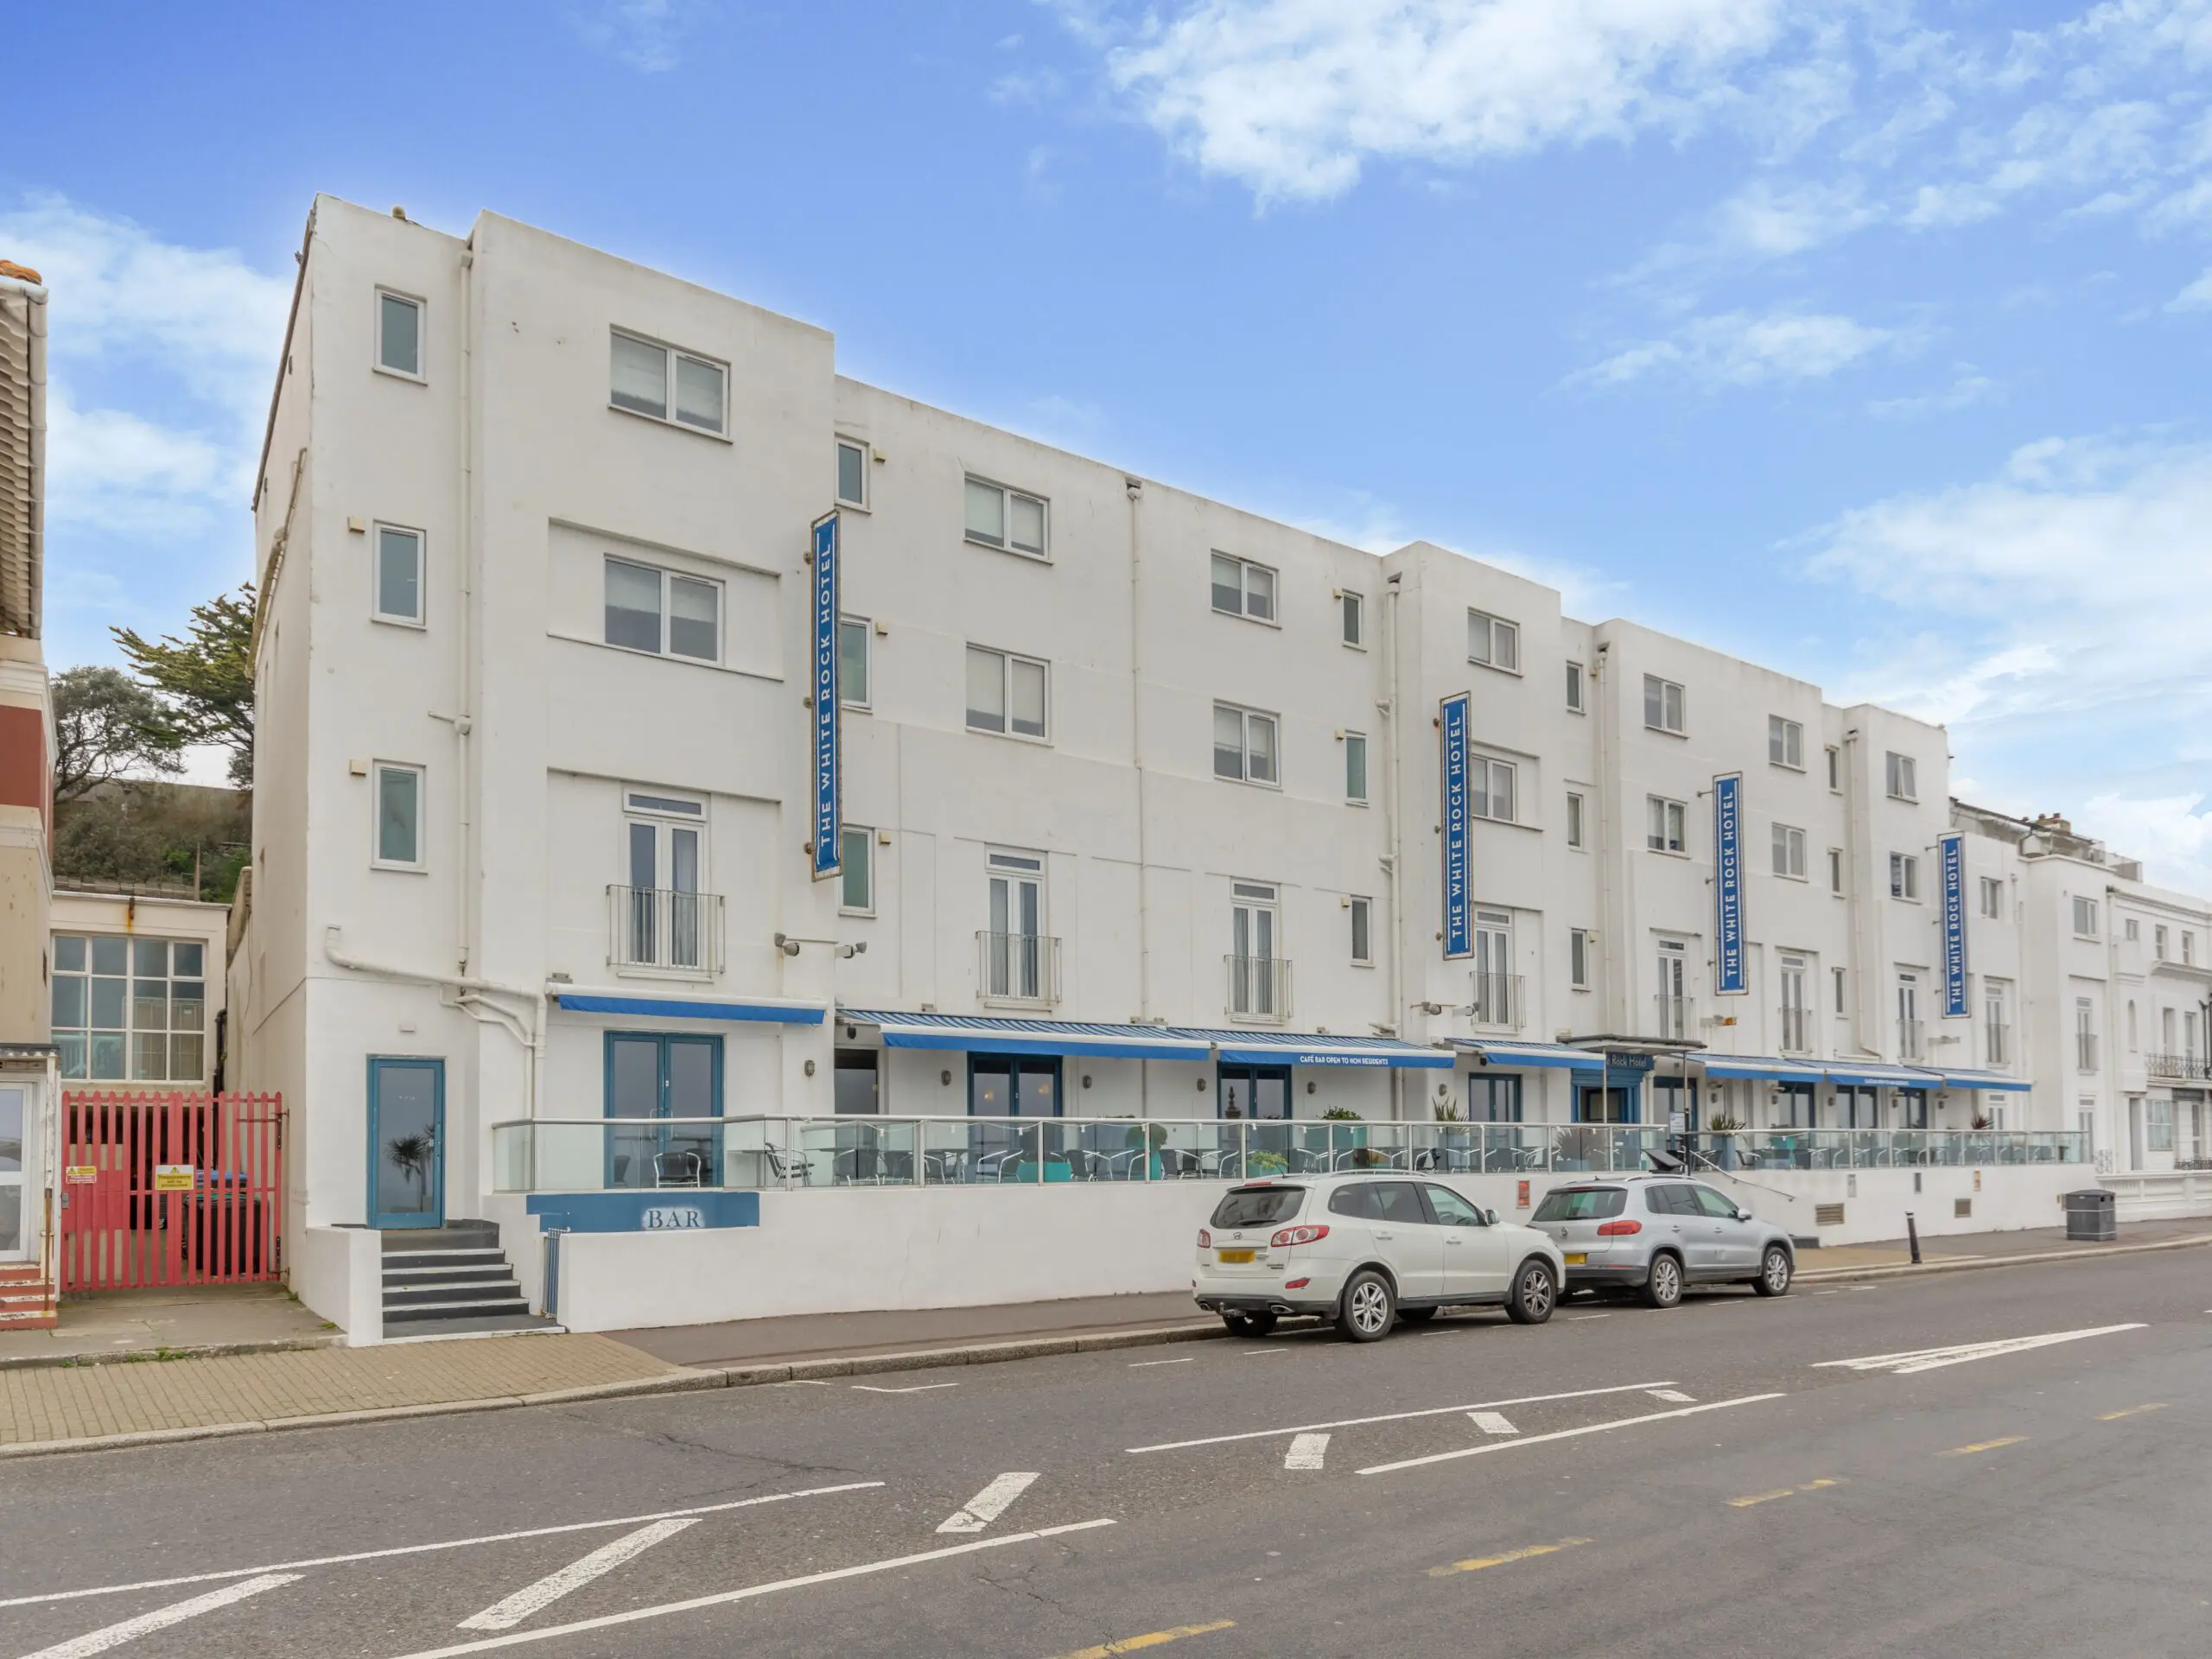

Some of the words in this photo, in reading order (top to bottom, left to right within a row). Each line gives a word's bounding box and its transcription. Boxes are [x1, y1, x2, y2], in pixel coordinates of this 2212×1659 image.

[821, 543, 830, 624] HOTEL
[820, 634, 830, 701] ROCK
[821, 712, 830, 790] WHITE
[1450, 717, 1461, 775] HOTEL
[821, 801, 831, 848] THE
[1451, 783, 1462, 832] ROCK
[1723, 791, 1734, 841] HOTEL
[1452, 839, 1462, 897] WHITE
[1724, 847, 1735, 888] ROCK
[1947, 849, 1958, 890] HOTEL
[1452, 905, 1462, 938] THE
[1725, 894, 1737, 942] WHITE
[1948, 895, 1959, 930] ROCK
[1726, 949, 1738, 977] THE
[1949, 935, 1961, 976] WHITE
[1951, 981, 1961, 1004] THE
[647, 1210, 701, 1229] BAR
